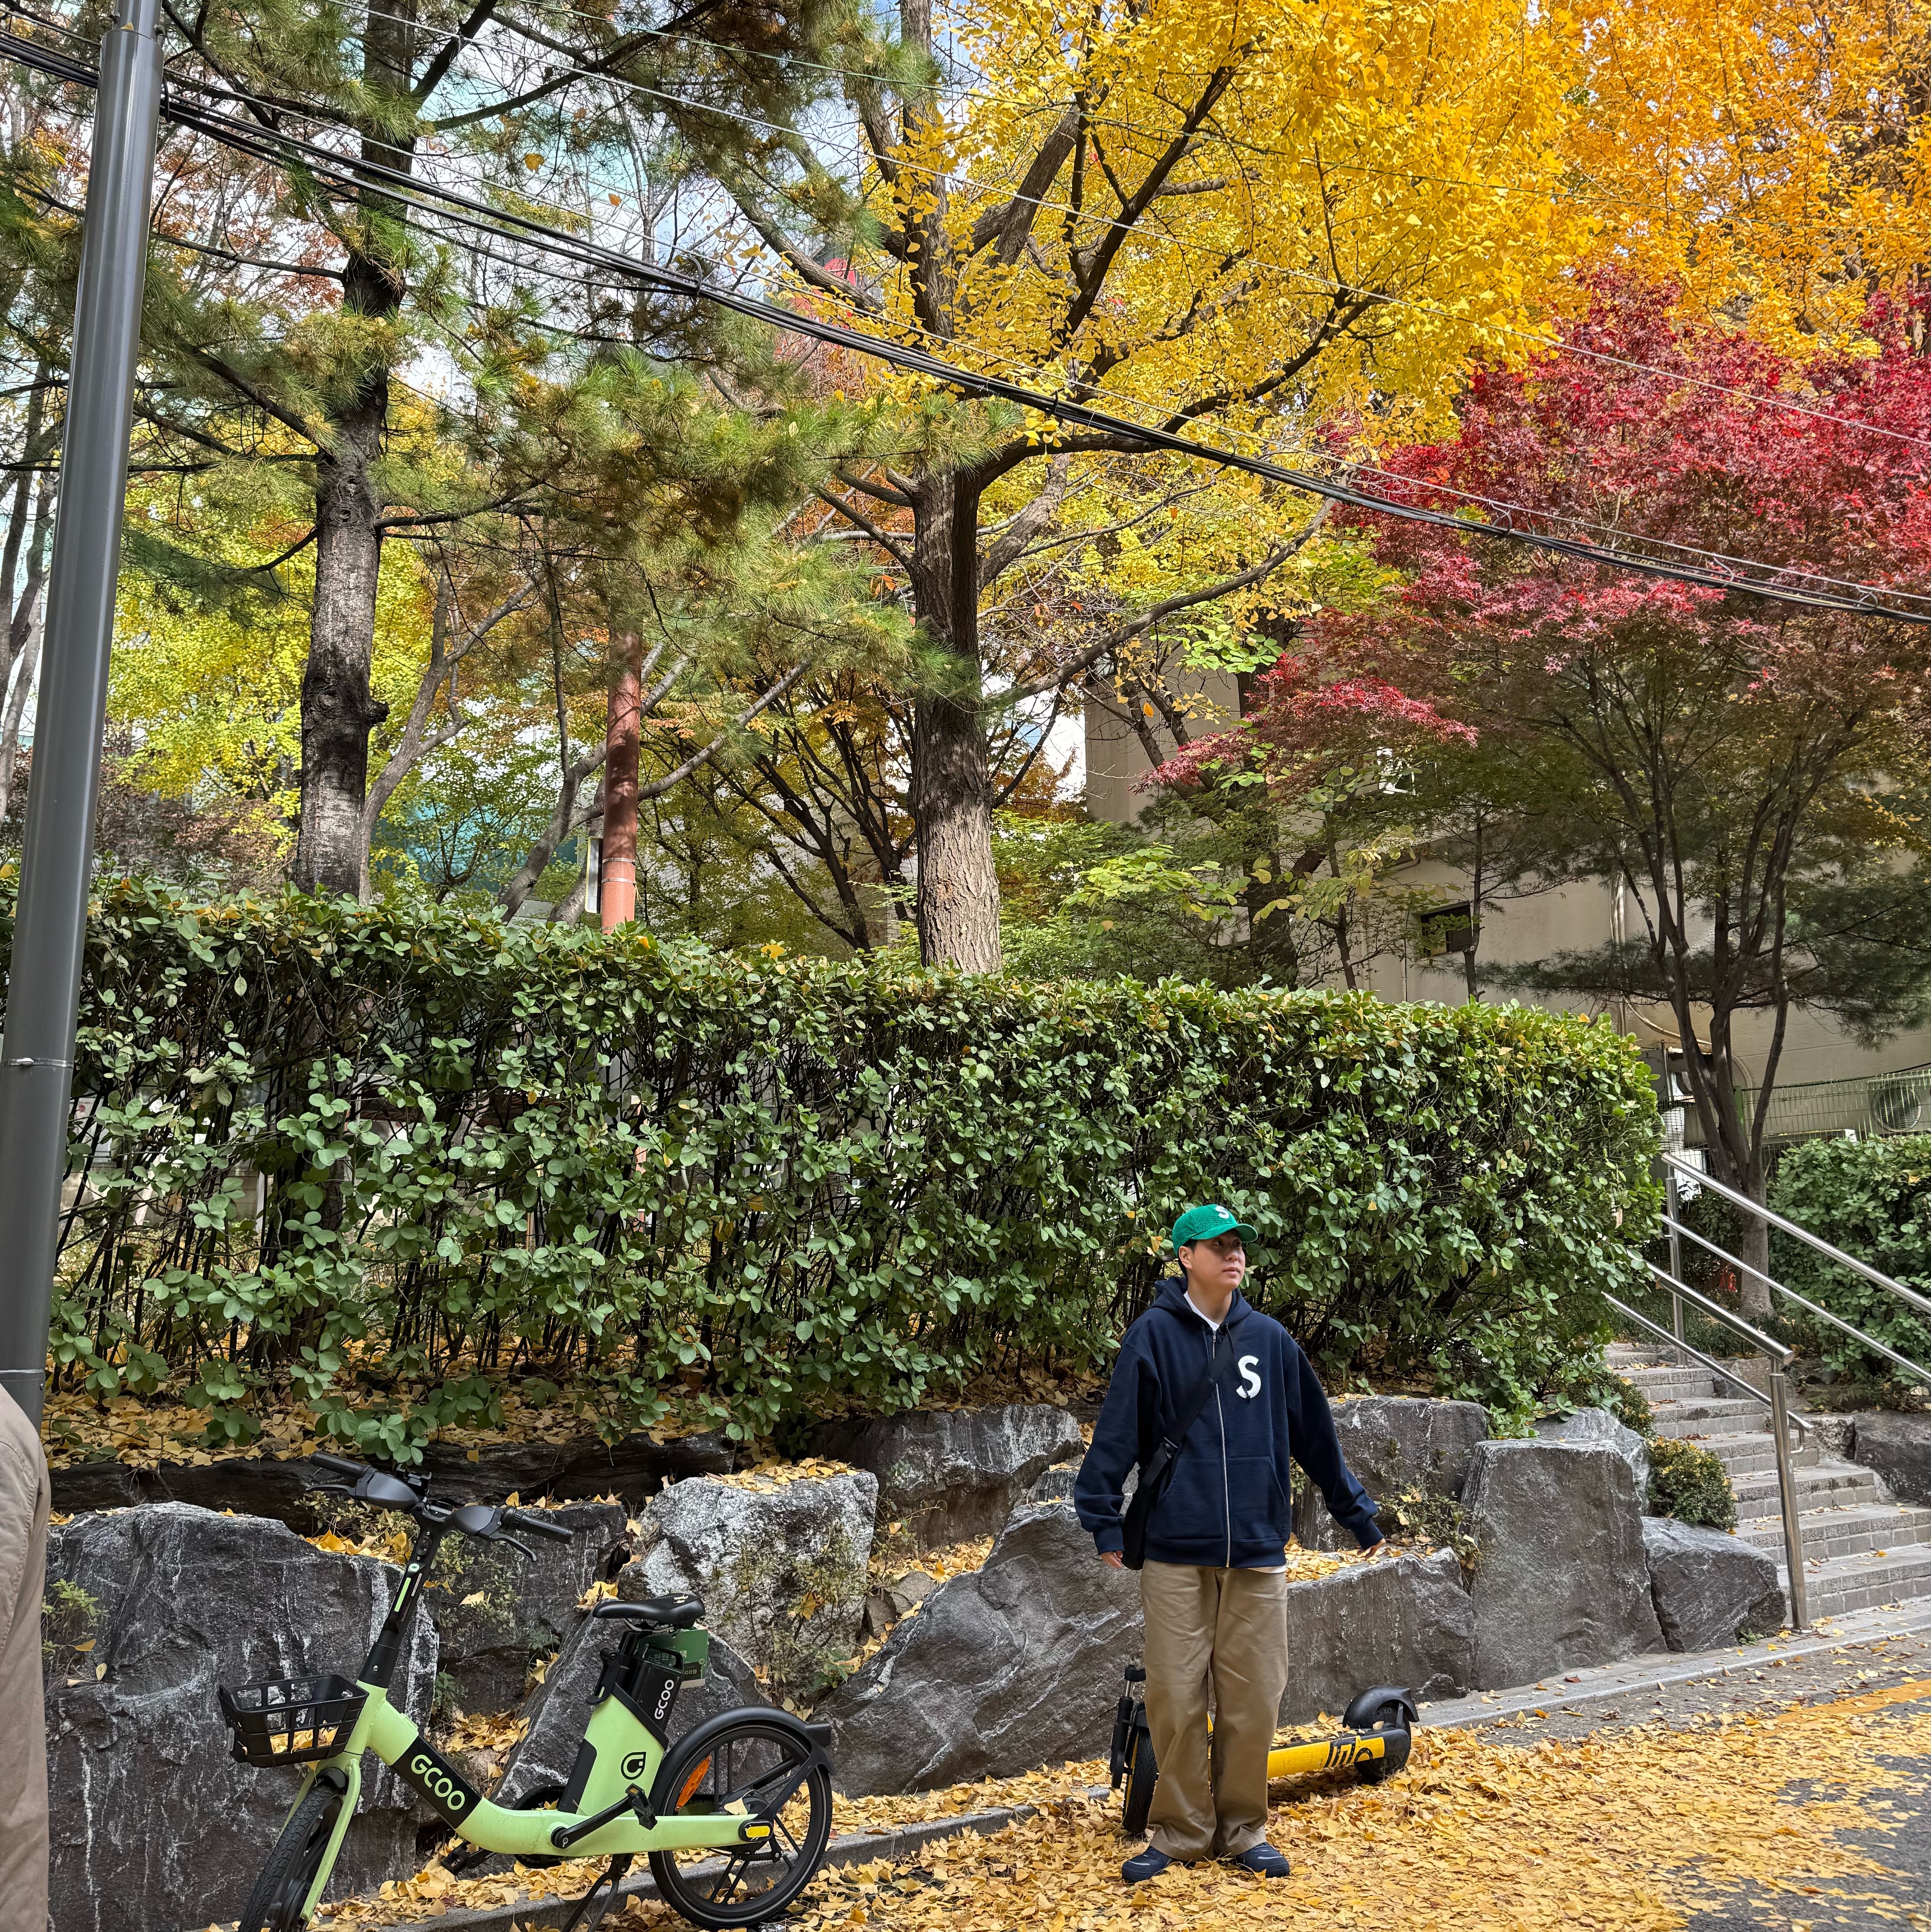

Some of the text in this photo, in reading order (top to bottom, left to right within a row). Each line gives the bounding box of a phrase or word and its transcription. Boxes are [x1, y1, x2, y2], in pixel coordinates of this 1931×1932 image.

[1215, 1205, 1229, 1219] S
[1236, 1355, 1261, 1399] S
[654, 1680, 674, 1720] GCOO
[411, 1754, 465, 1810] GCOO
